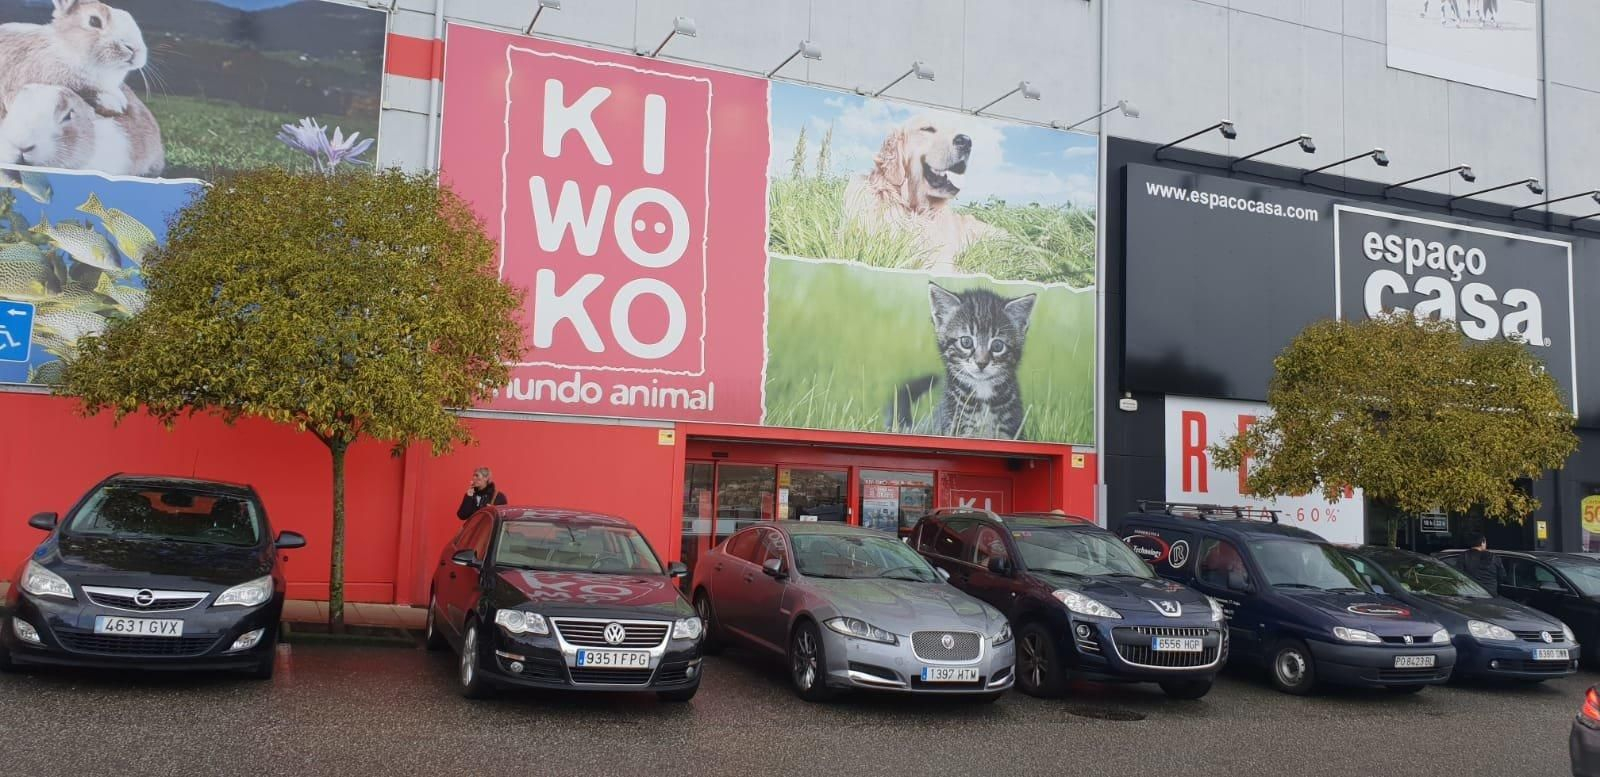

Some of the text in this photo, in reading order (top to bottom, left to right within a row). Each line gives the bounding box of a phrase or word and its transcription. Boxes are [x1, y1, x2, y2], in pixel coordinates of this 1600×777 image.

[542, 77, 668, 175] KI
[528, 174, 690, 269] WO
[1145, 181, 1319, 222] www.espacocasa.com
[1363, 231, 1487, 282] espaço
[533, 267, 687, 360] KO
[1363, 269, 1545, 347] casa
[609, 378, 715, 412] animal
[105, 619, 178, 634] 4631 GVX
[1159, 639, 1200, 650] 6556 HGP
[586, 652, 646, 666] 9351 FPG
[930, 668, 954, 680] 1397
